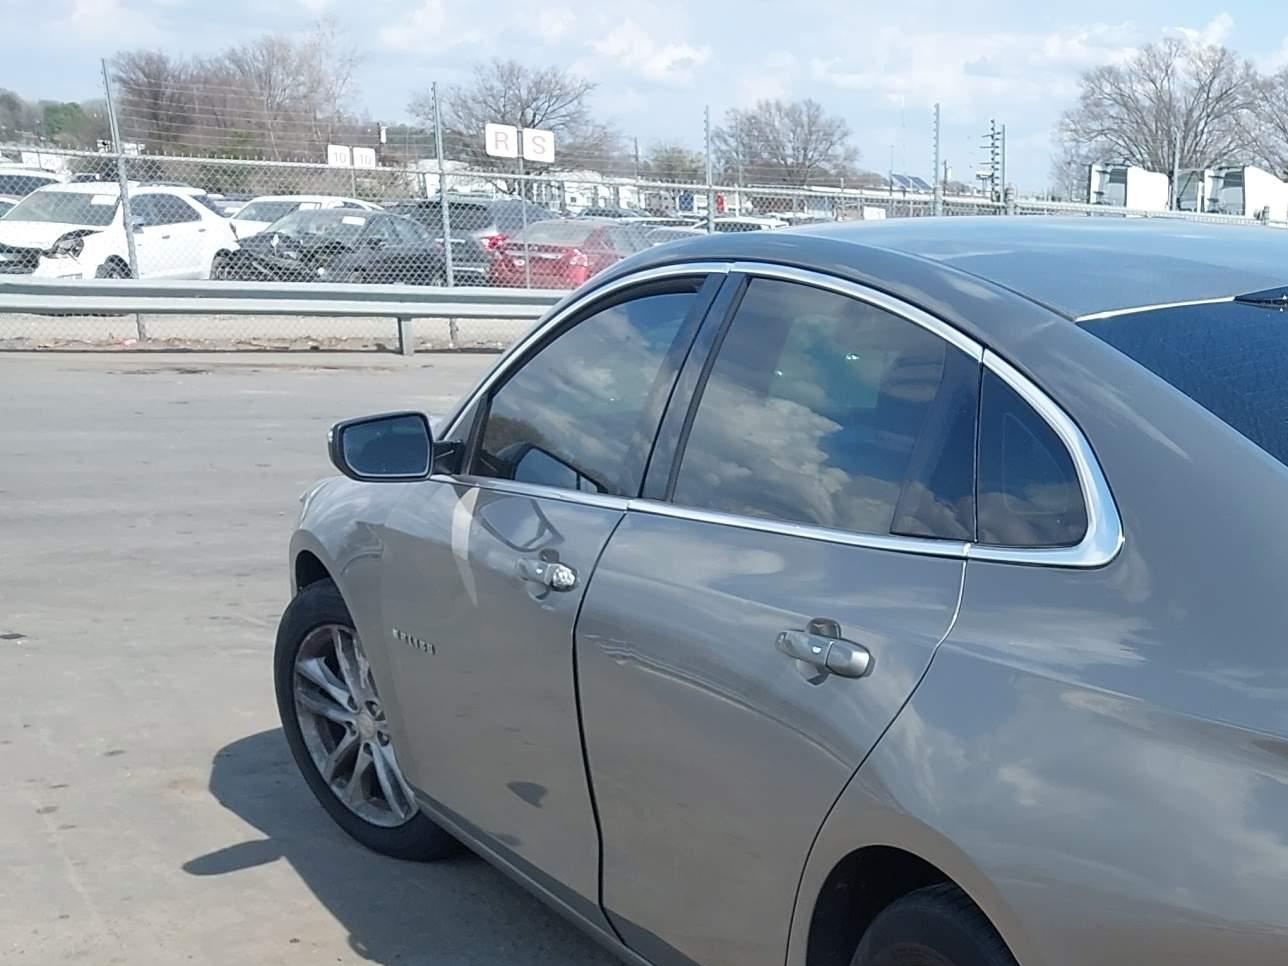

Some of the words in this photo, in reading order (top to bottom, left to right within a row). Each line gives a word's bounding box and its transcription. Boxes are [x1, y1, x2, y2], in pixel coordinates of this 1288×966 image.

[494, 130, 510, 151] R
[531, 135, 547, 155] S
[333, 151, 347, 164] 10
[359, 154, 372, 165] 10
